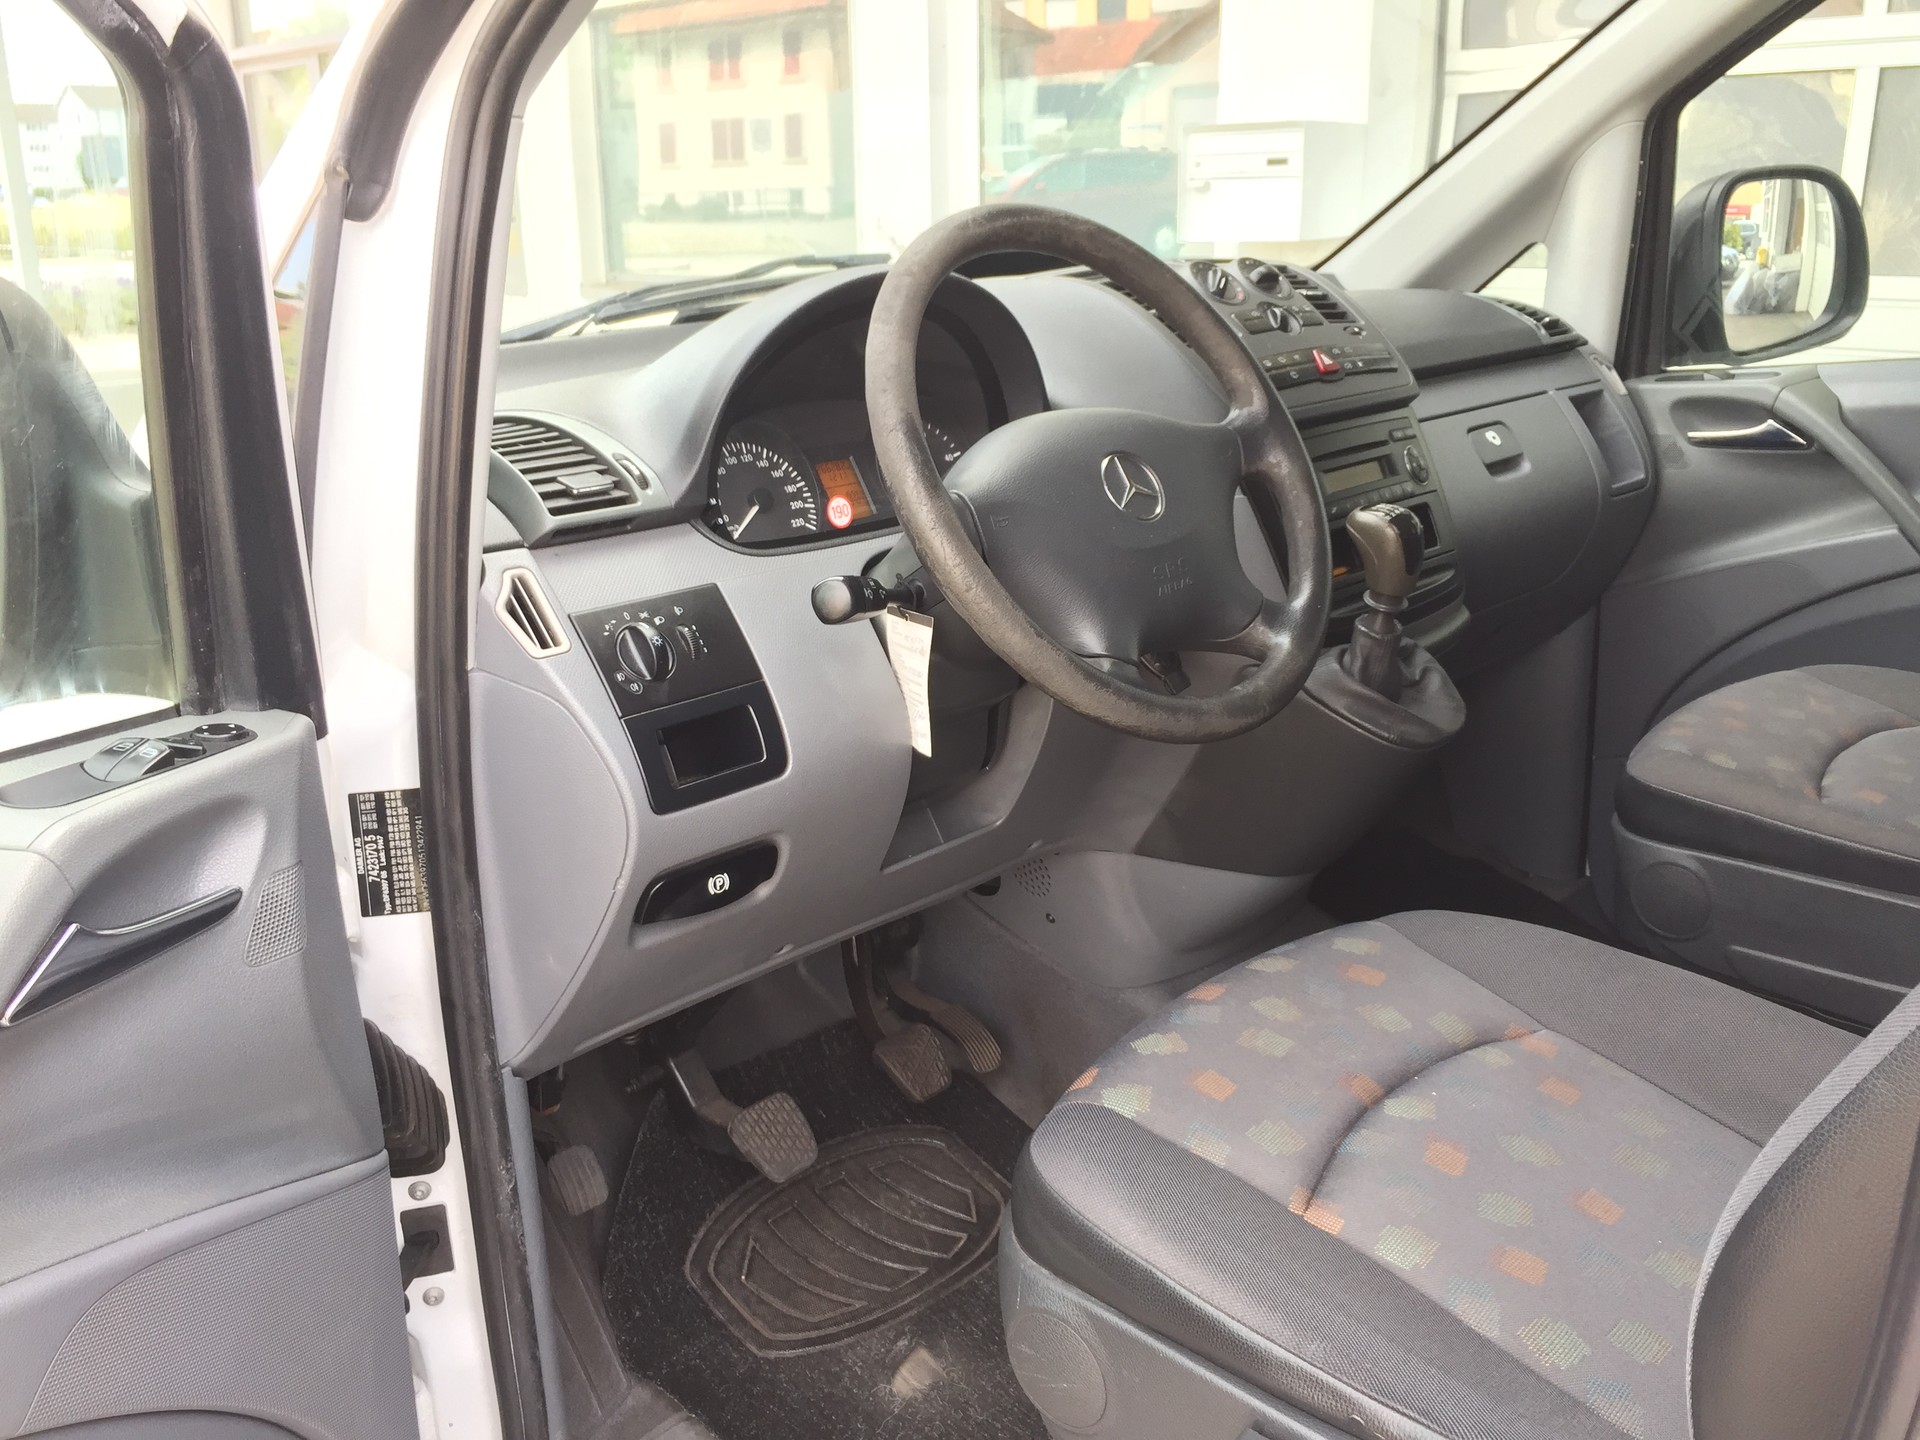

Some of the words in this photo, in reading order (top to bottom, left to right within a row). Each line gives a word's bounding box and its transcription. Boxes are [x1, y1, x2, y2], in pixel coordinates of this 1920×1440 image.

[724, 456, 738, 466] 100
[740, 453, 754, 463] 120
[756, 459, 769, 469] 140
[770, 469, 784, 478] 160
[784, 484, 797, 494] 180
[790, 500, 804, 510] 200
[831, 504, 850, 519] 190
[723, 513, 730, 522] 0
[790, 518, 805, 528] 220
[354, 837, 362, 847] AG
[364, 834, 376, 842] 5
[355, 848, 365, 875] DAIMLER
[365, 843, 381, 883] 7423170
